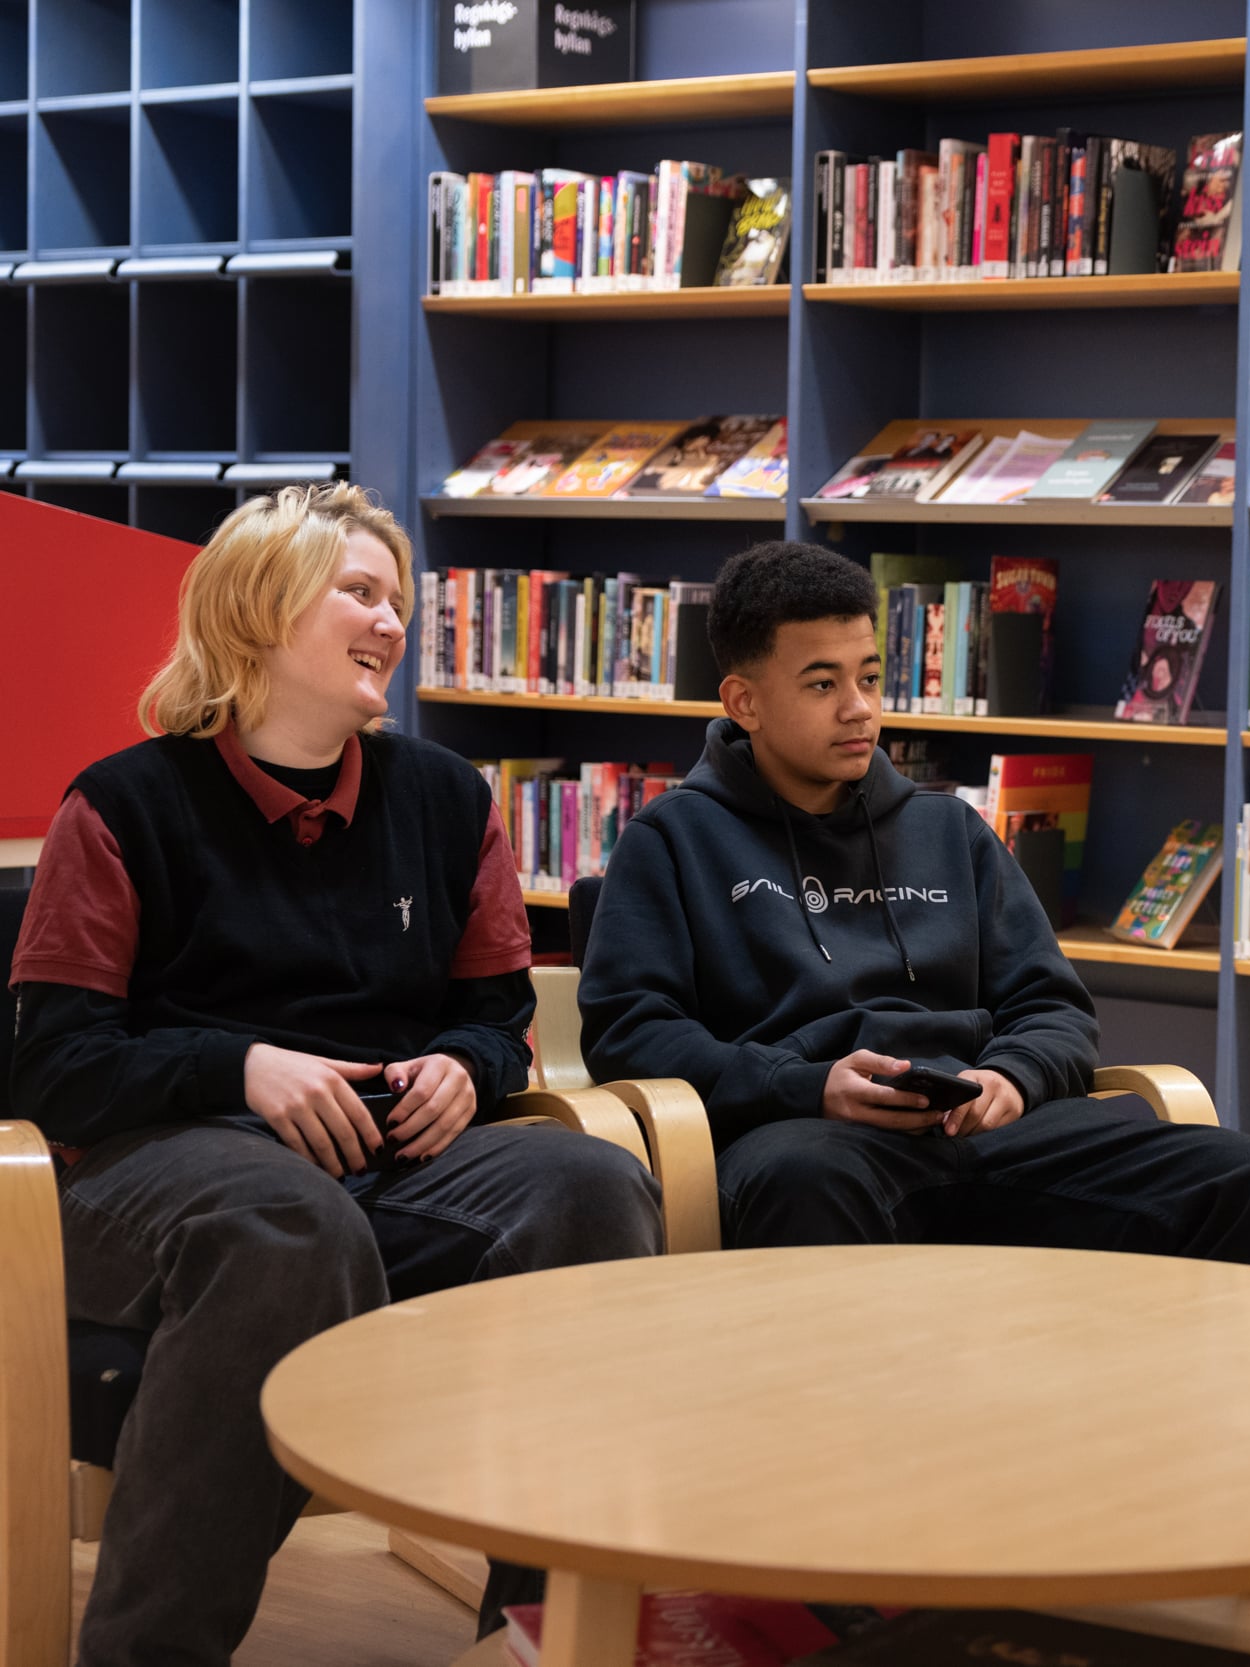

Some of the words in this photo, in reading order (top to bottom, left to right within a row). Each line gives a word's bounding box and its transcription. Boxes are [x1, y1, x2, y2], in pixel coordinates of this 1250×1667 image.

[454, 26, 491, 53] hyllan
[555, 27, 592, 55] hyllan
[731, 878, 795, 903] SAIL
[833, 887, 948, 904] RACING
